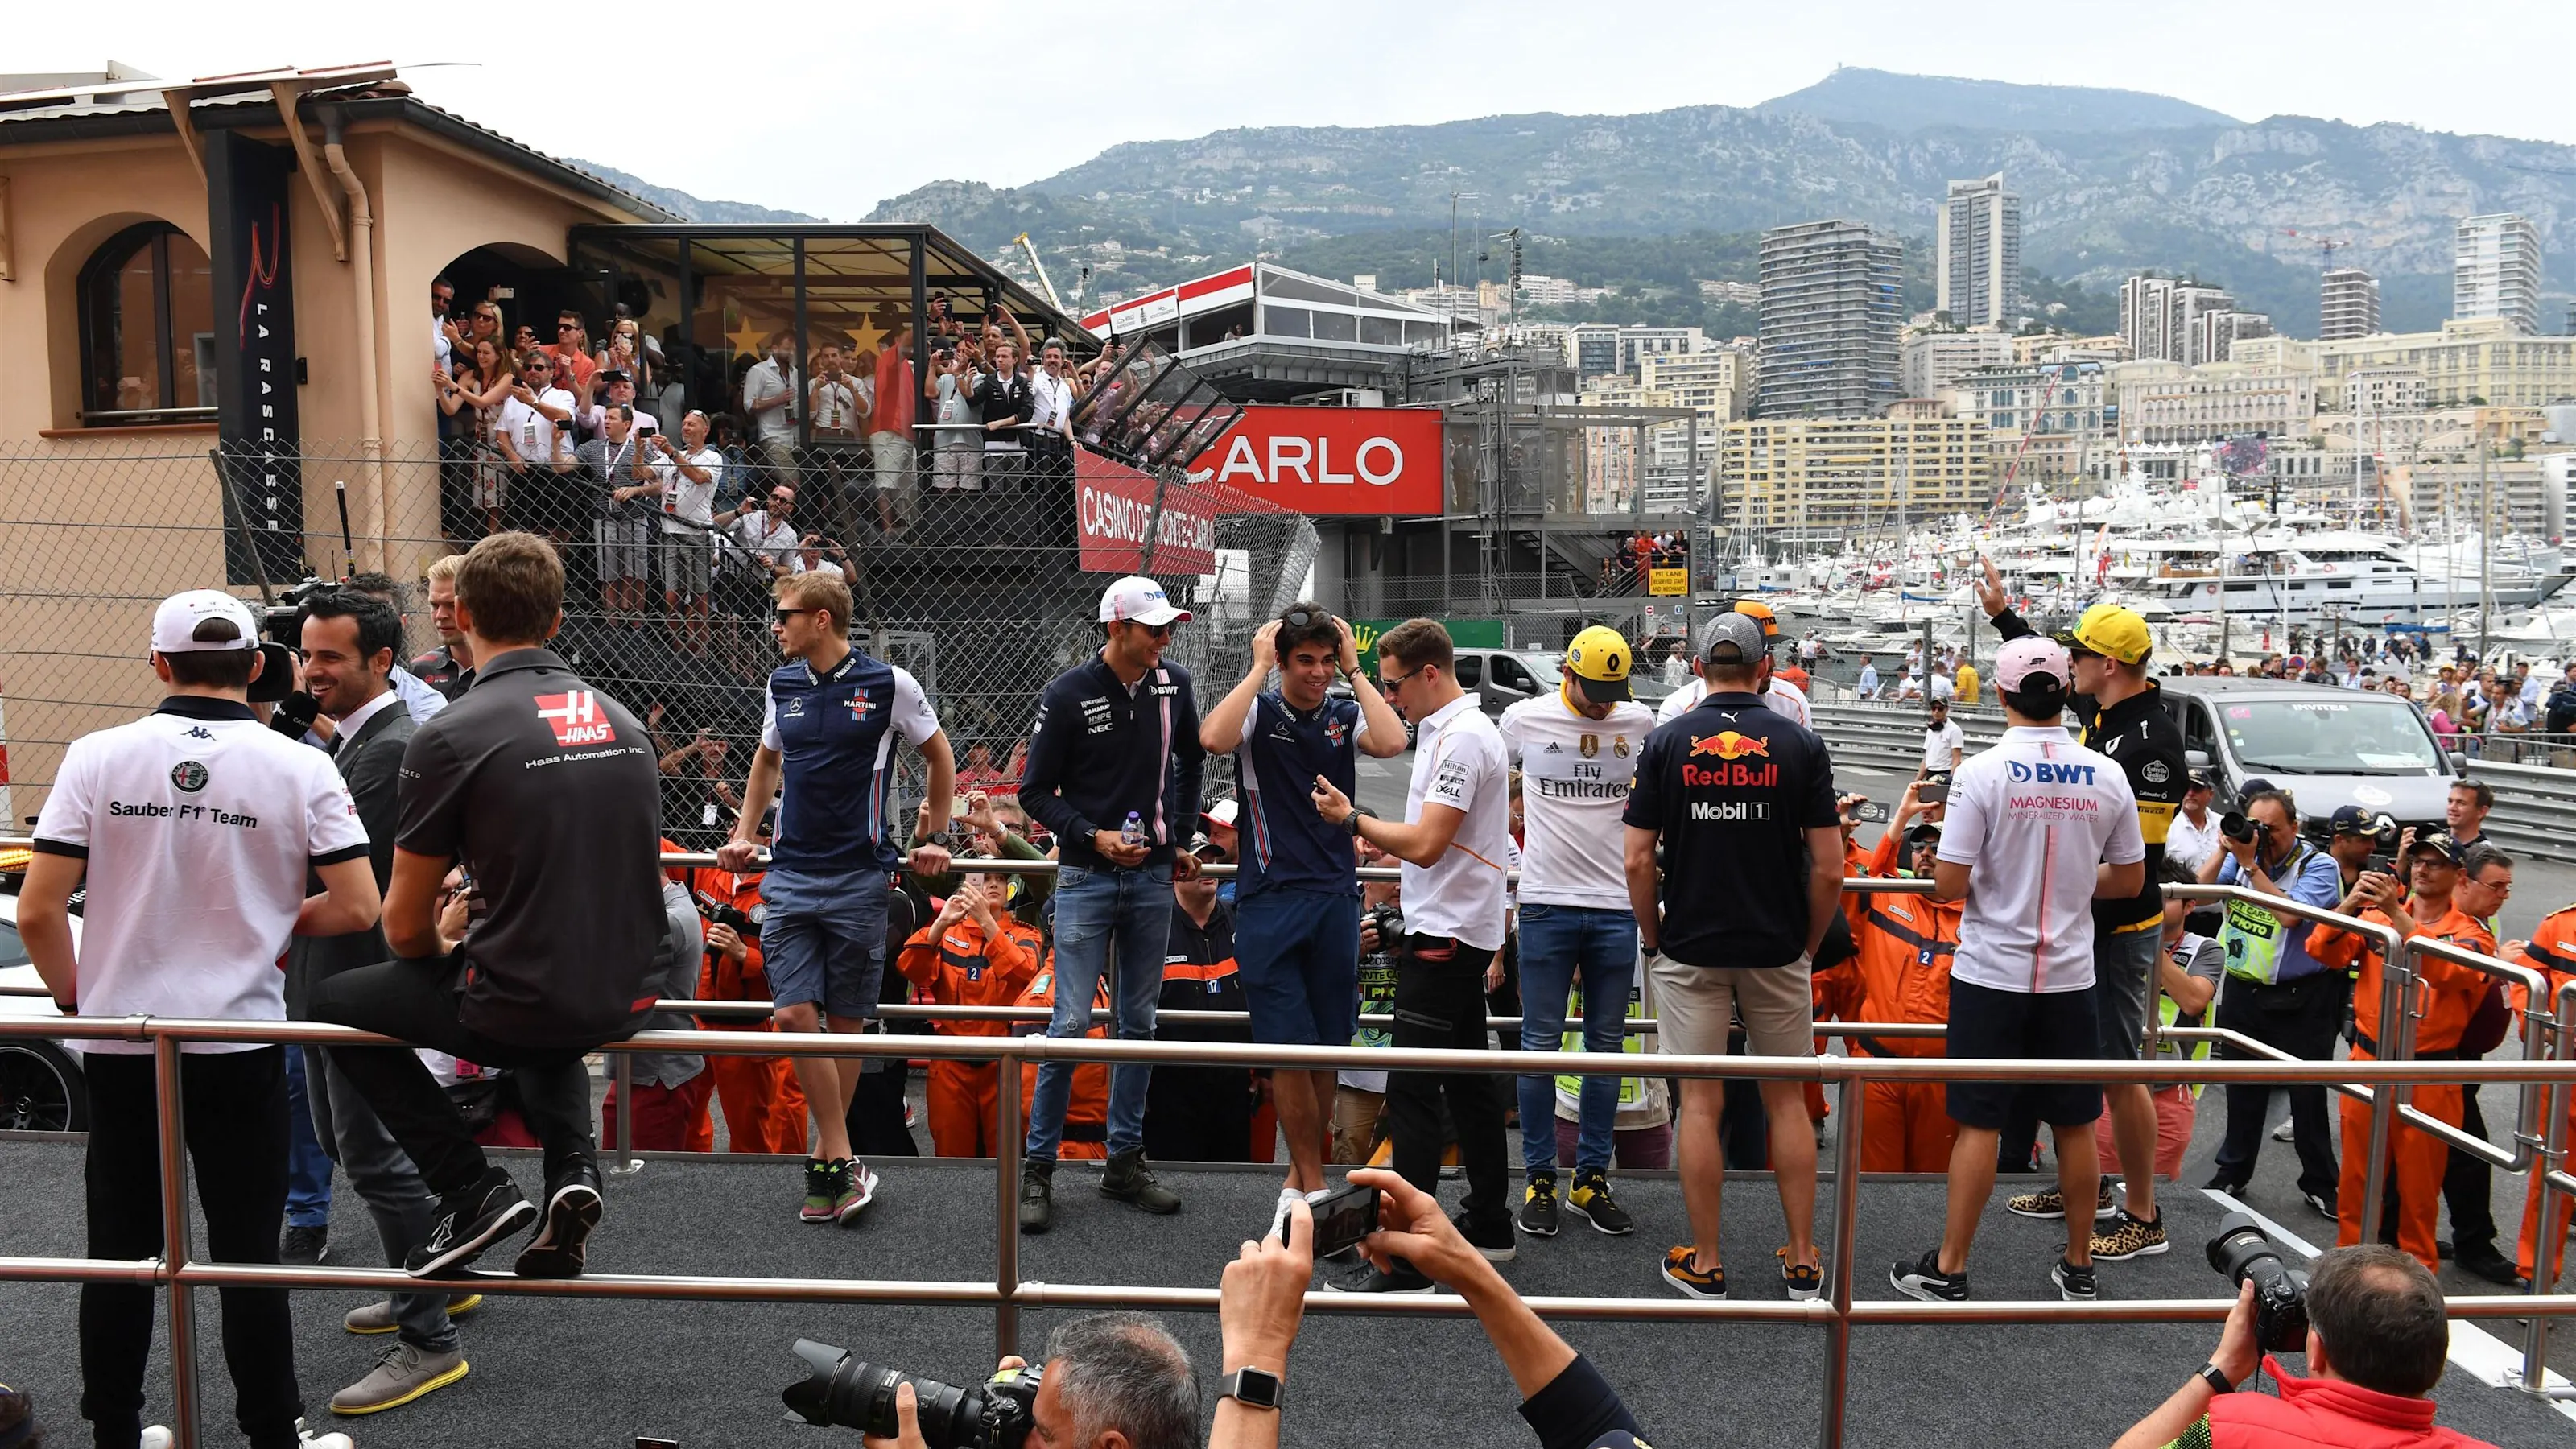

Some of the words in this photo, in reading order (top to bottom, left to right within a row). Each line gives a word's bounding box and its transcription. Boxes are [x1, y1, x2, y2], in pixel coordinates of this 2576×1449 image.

[257, 303, 269, 338] LA
[260, 357, 279, 531] RASCASSE
[1083, 486, 1135, 542] CASINO
[833, 658, 857, 683] Rexona
[1158, 686, 1179, 695] BWT
[844, 700, 877, 710] MARTINI
[1088, 711, 1112, 724] HYPE
[556, 723, 612, 743] HAAS
[1088, 722, 1113, 735] NEC
[525, 755, 560, 769] Haas
[564, 747, 626, 761] Automation
[629, 746, 646, 754] Inc.
[1443, 762, 1466, 773] Hilton
[1574, 764, 1601, 780] Fly
[1682, 762, 1728, 786] Red
[1732, 763, 1778, 787] Bull
[2036, 762, 2095, 786] BWT
[1539, 778, 1631, 798] Emirates
[1691, 802, 1747, 820] Mobil
[2009, 795, 2098, 811] MAGNESIUM
[109, 801, 173, 817] Sauber
[210, 808, 258, 828] Team
[2069, 813, 2099, 823] WATER
[2231, 914, 2268, 935] PHOTO
[1921, 952, 1930, 964] 2
[970, 968, 978, 980] 2
[1208, 980, 1218, 993] 17
